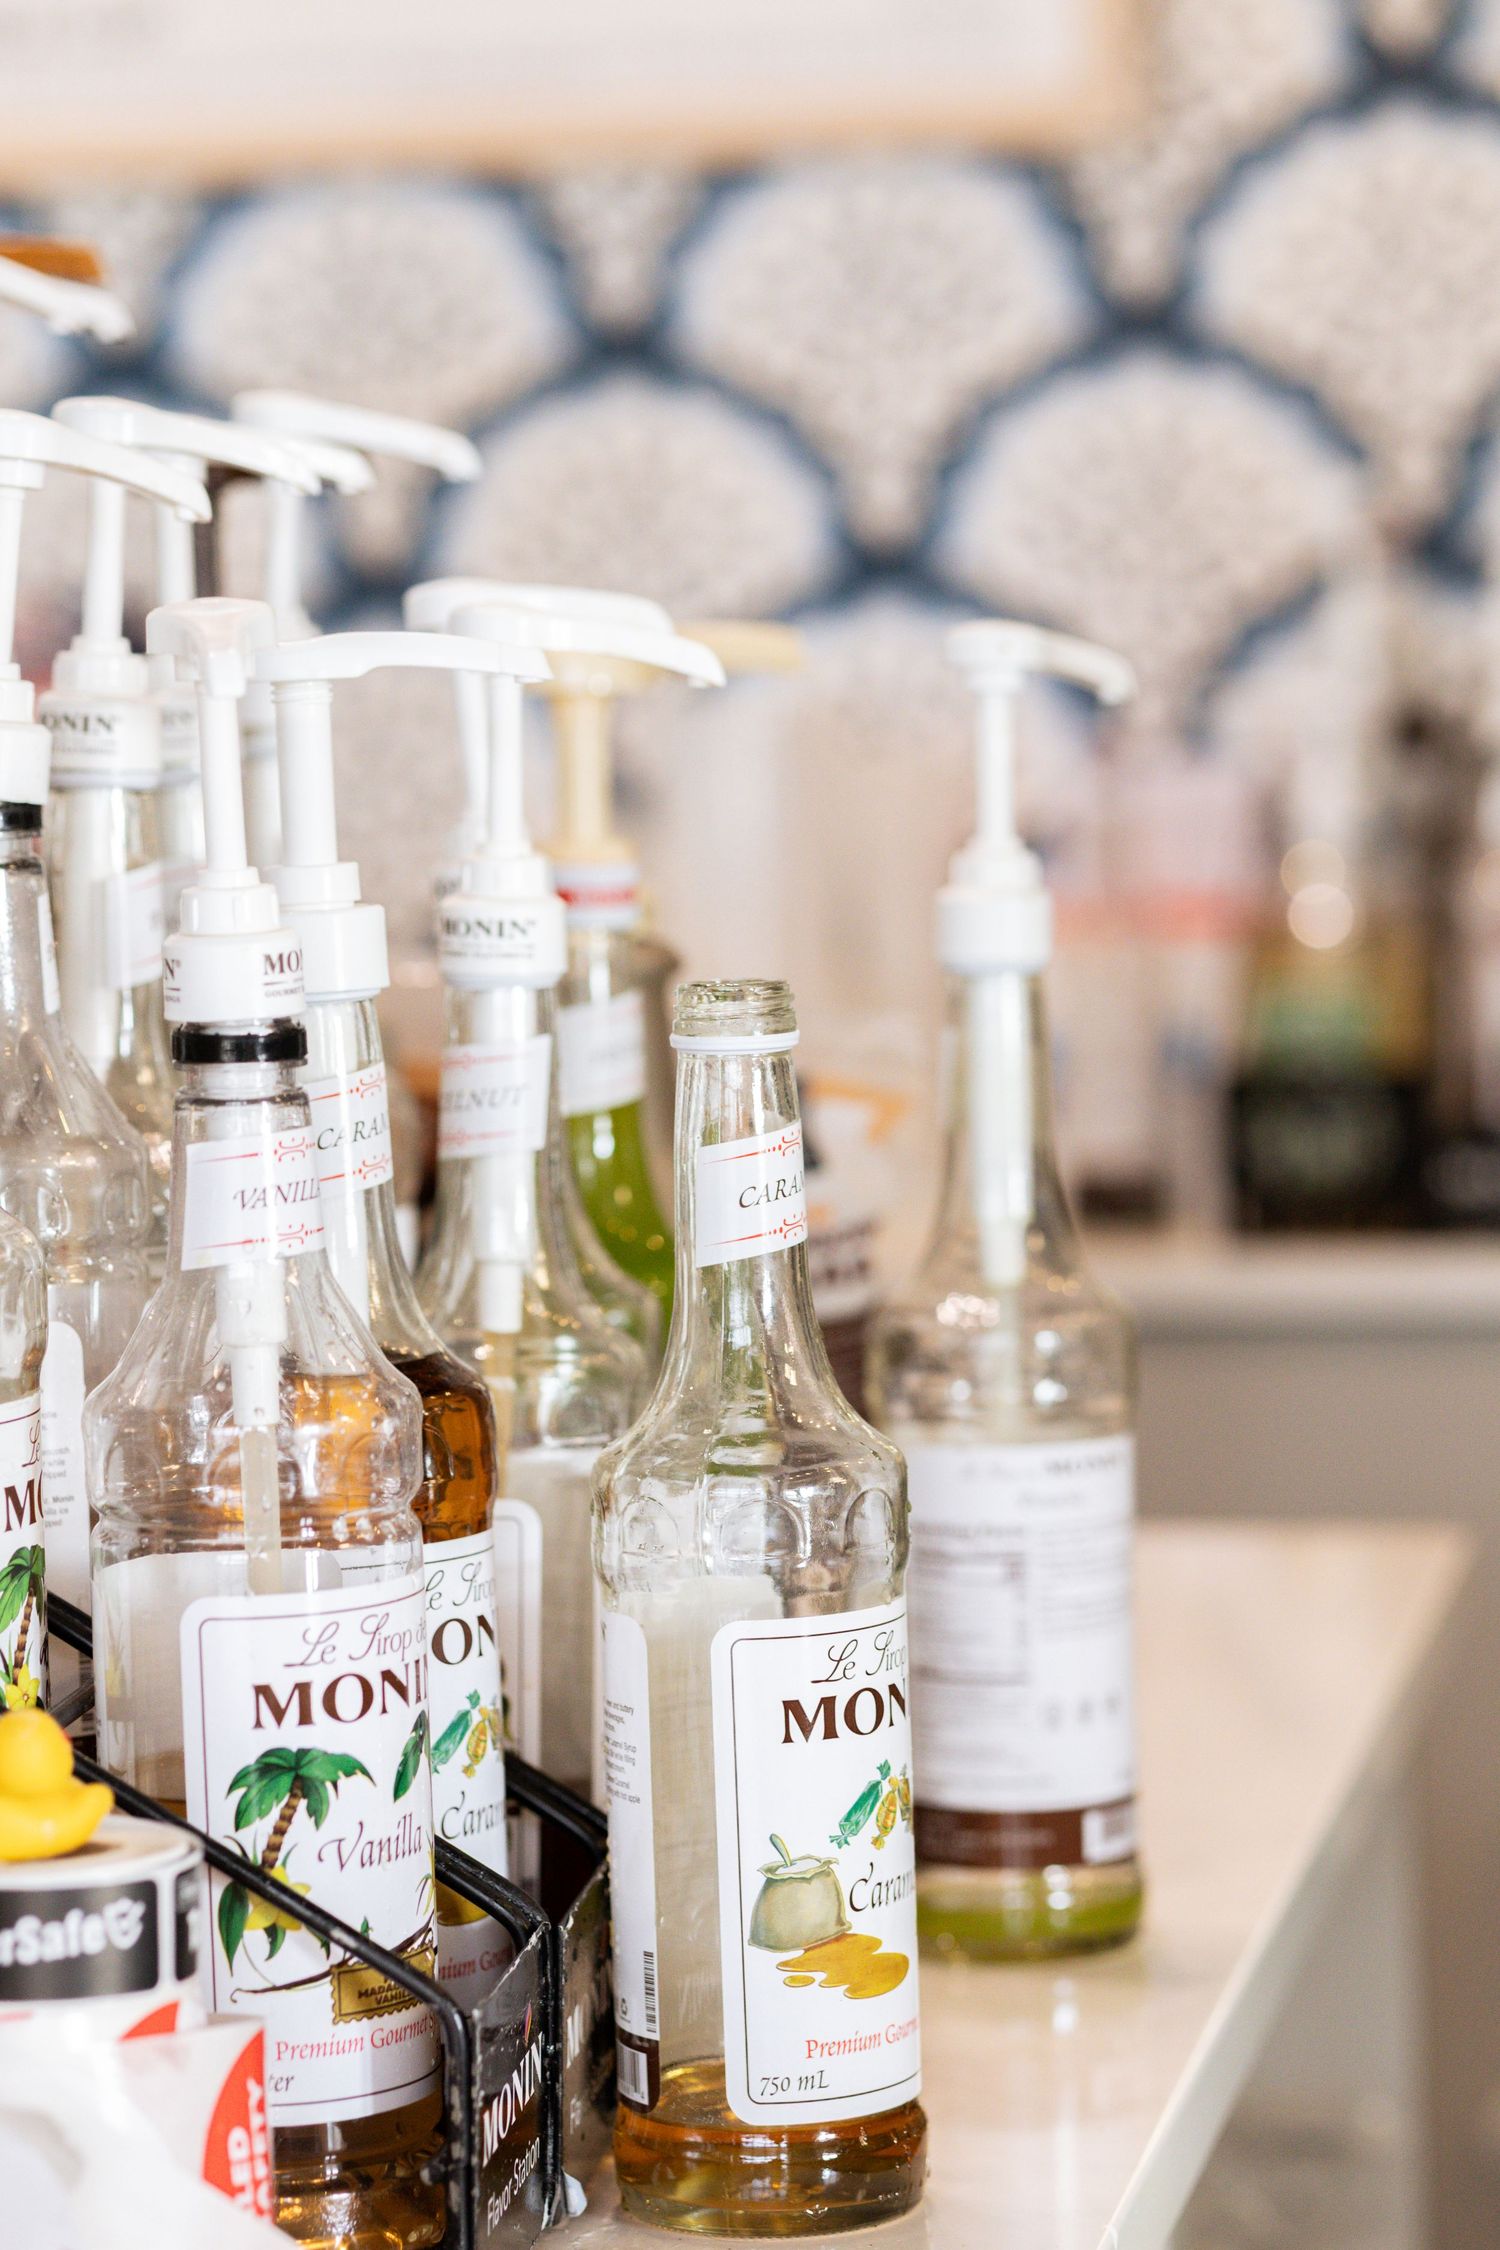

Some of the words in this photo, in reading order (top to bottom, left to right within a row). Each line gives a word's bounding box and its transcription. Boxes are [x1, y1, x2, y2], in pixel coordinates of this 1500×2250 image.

[233, 1178, 320, 1210] VANILL
[283, 1621, 340, 1668] Le
[811, 1639, 858, 1683] Le
[318, 1811, 423, 1872] Vanilla
[275, 2033, 364, 2061] Premium
[370, 2013, 427, 2049] Gourmet
[805, 2030, 881, 2059] Premium
[482, 2031, 542, 2169] MONIN
[760, 2073, 791, 2096] 750
[798, 2069, 830, 2091] mL
[487, 2178, 512, 2237] Flavor
[514, 2137, 540, 2196] Station
